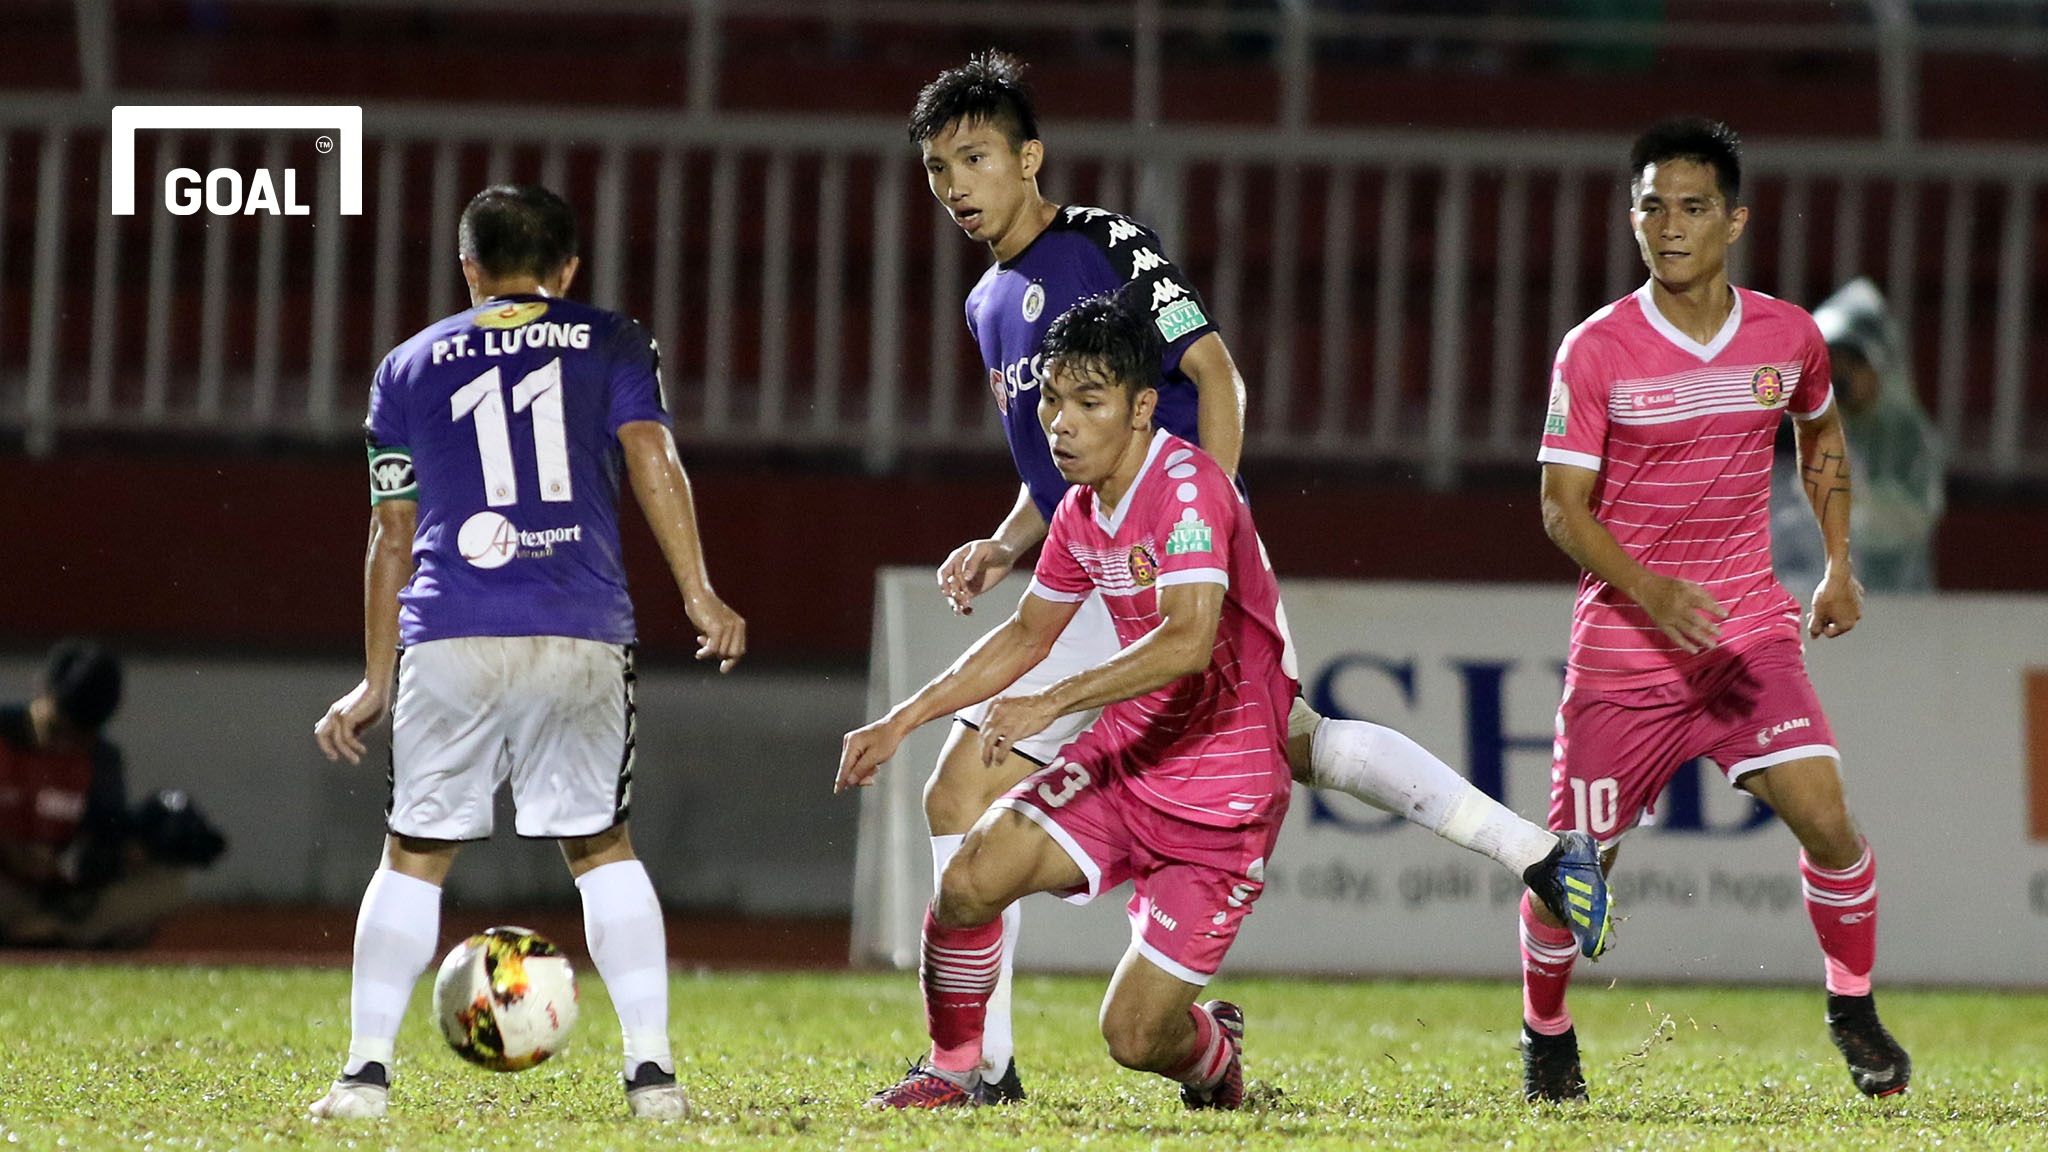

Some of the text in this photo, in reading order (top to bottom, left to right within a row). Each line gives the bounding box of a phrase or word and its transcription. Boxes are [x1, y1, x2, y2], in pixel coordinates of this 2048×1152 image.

[1160, 304, 1199, 331] NUTI
[432, 335, 475, 364] P.T.
[450, 357, 572, 507] 11
[1169, 529, 1209, 543] NUTI
[1772, 718, 1811, 736] KAMI
[1570, 777, 1618, 834] 10
[1150, 904, 1177, 931] KAMI
